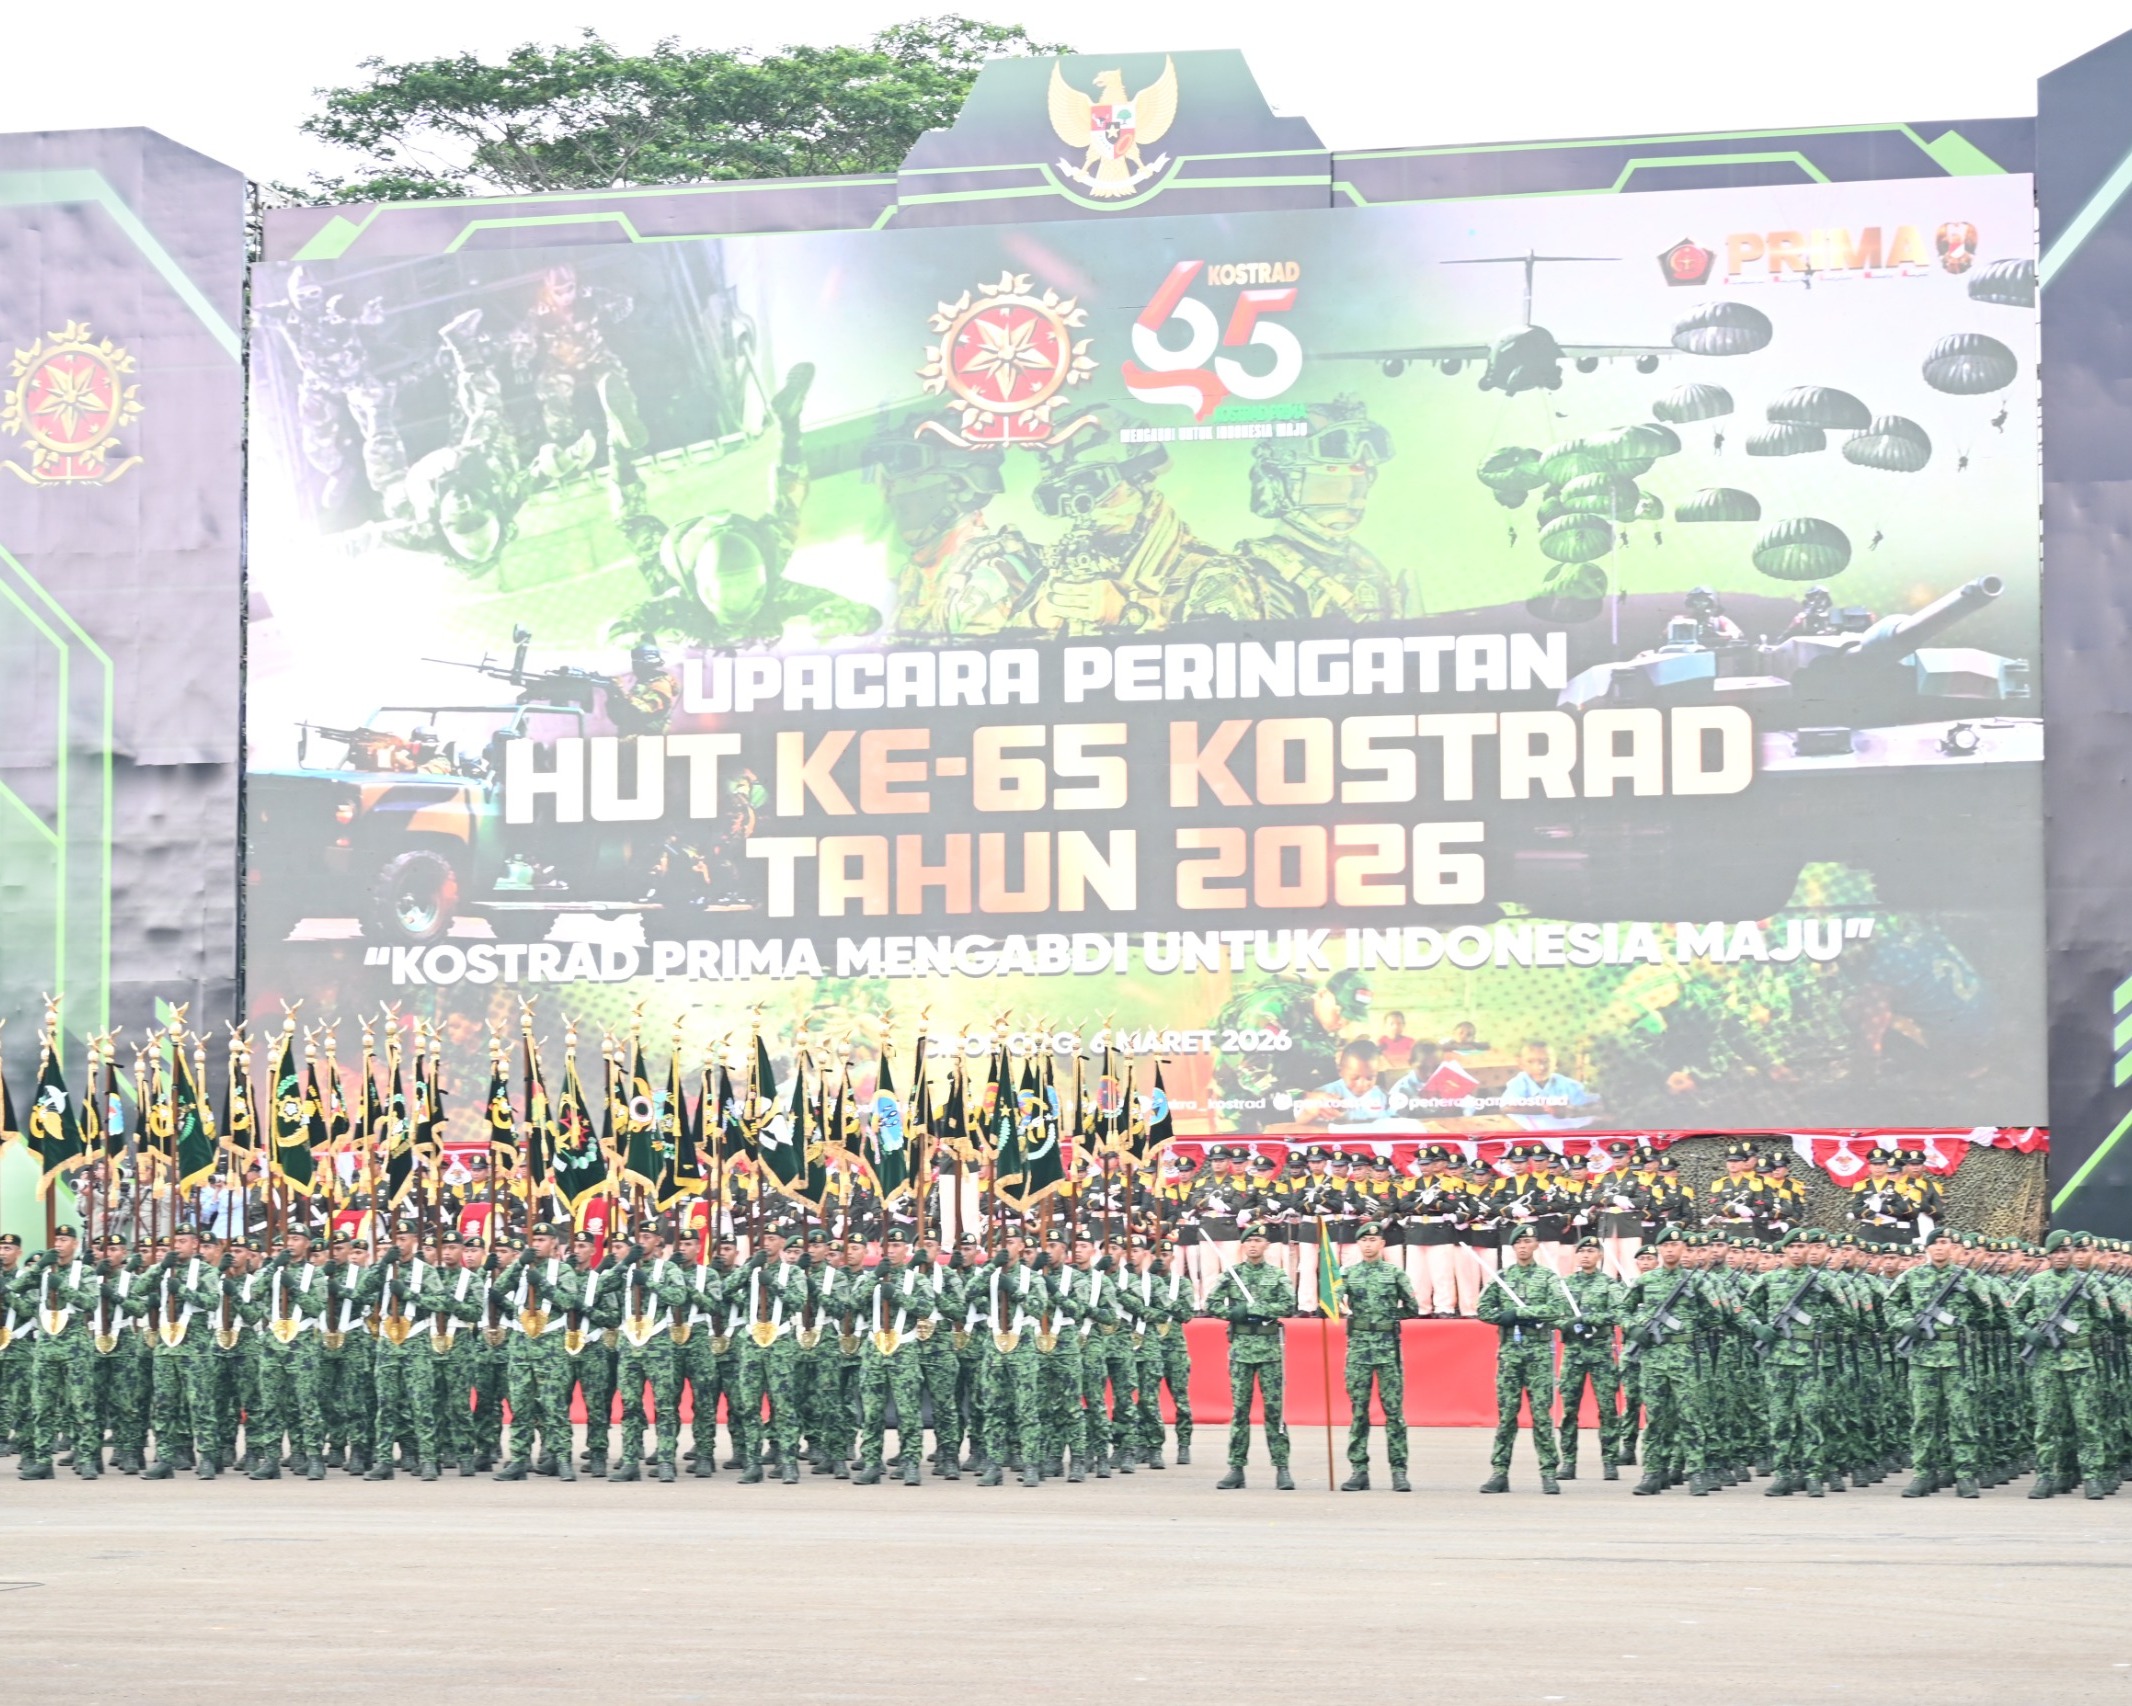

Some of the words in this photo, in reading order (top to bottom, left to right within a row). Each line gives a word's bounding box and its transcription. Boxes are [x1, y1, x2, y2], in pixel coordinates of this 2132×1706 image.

[1208, 261, 1301, 286] KOSTRAD
[1726, 225, 1930, 275] PRIMA
[1131, 259, 1303, 400] 65
[683, 648, 1040, 714] UPACARA
[1063, 632, 1568, 703] PERINGATAN
[505, 732, 742, 824] HUT
[775, 723, 1128, 817] KE-65
[1169, 705, 1754, 808] KOSTRAD
[746, 829, 1137, 918] TAHUN
[1176, 821, 1486, 909] 2026
[653, 937, 823, 982] PRIMA
[836, 932, 1129, 980] MENGABDI
[1143, 928, 1332, 973] UNTUK
[1345, 922, 1668, 969] INDONESIA
[1115, 1029, 1217, 1055] MARET
[1221, 1029, 1293, 1053] 2026
